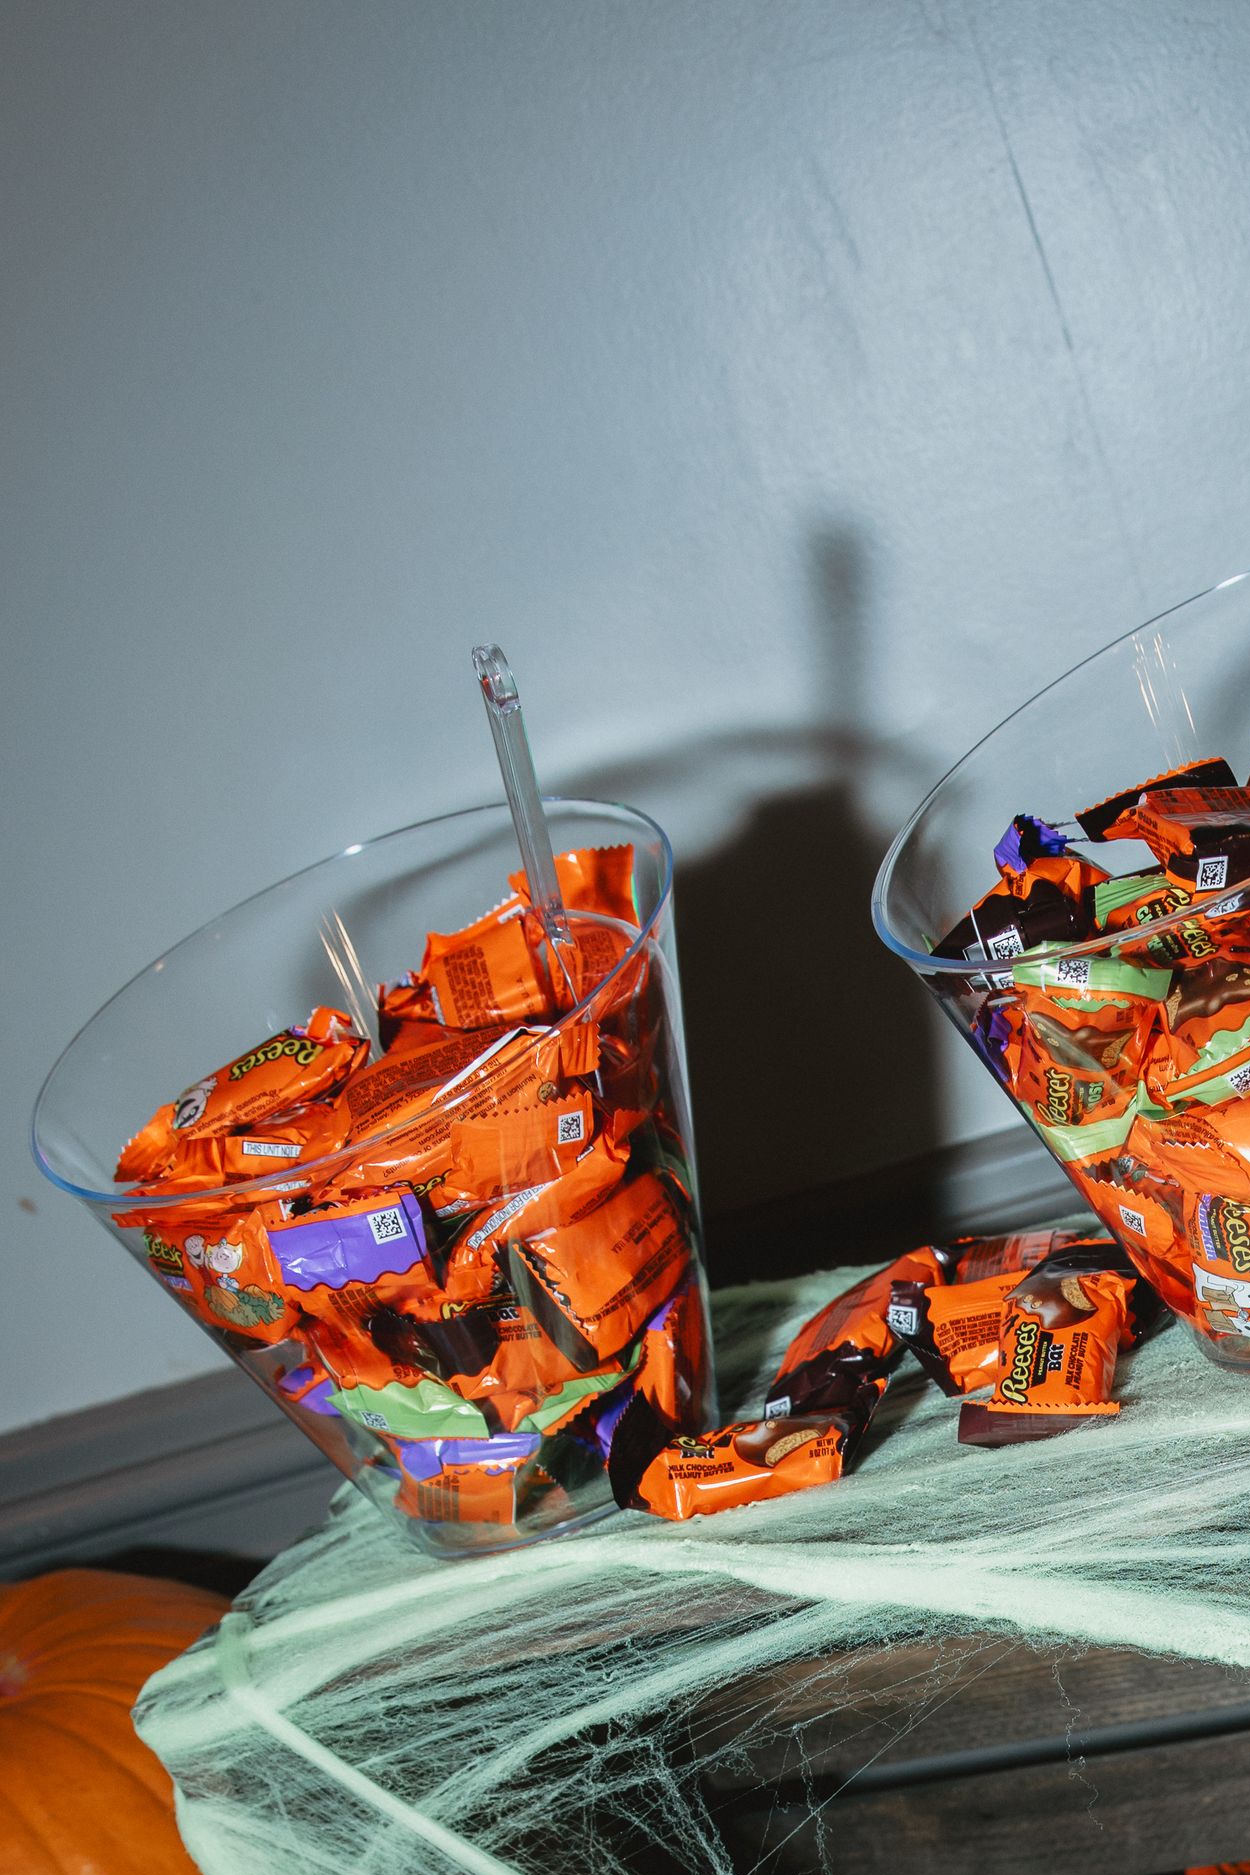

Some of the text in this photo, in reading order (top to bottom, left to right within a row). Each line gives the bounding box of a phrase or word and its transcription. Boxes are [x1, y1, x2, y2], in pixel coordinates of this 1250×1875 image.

[228, 1037, 325, 1082] Reese's
[1047, 1343, 1065, 1372] Bat
[1068, 1332, 1081, 1367] CHOCOLATE
[1078, 1332, 1089, 1360] BUTTER
[1000, 1320, 1041, 1404] Reese's
[1074, 1359, 1084, 1384] PEANUT
[675, 1471, 702, 1480] PEANUT
[703, 1466, 735, 1477] BUTTER
[686, 1461, 733, 1472] CHOCOLATE
